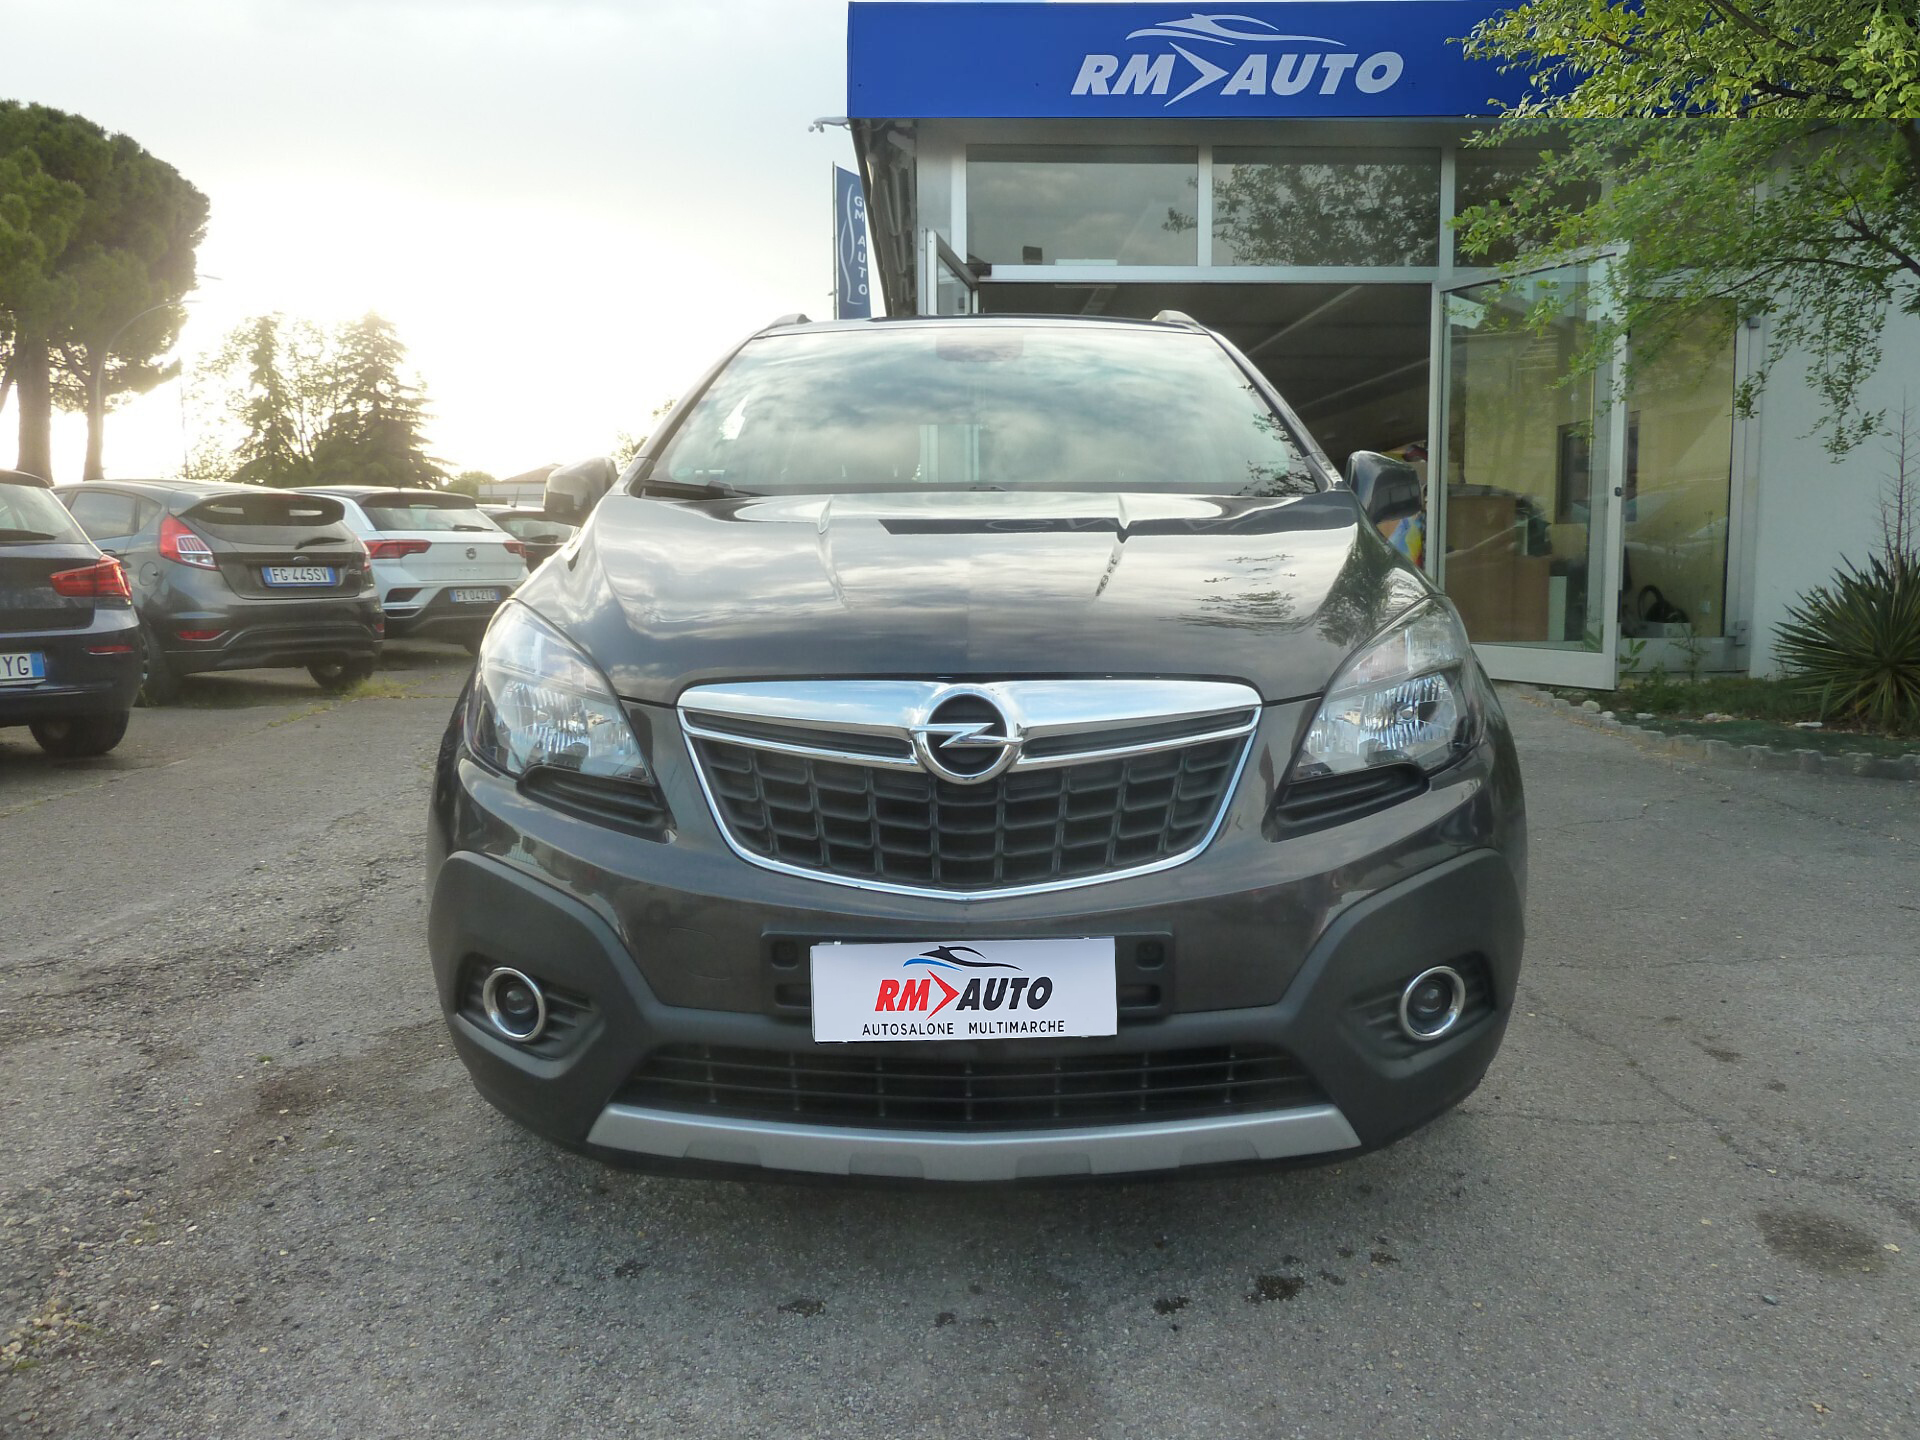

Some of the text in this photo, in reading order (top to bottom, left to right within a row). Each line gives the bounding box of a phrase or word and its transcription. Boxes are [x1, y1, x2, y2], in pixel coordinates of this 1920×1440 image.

[1070, 51, 1404, 96] RM AUTO
[854, 196, 868, 295] GM AUTO
[0, 656, 29, 676] YG
[874, 976, 1053, 1012] RM AUTO
[862, 1020, 1065, 1036] AUTOSALONE MULTIMARCHE
